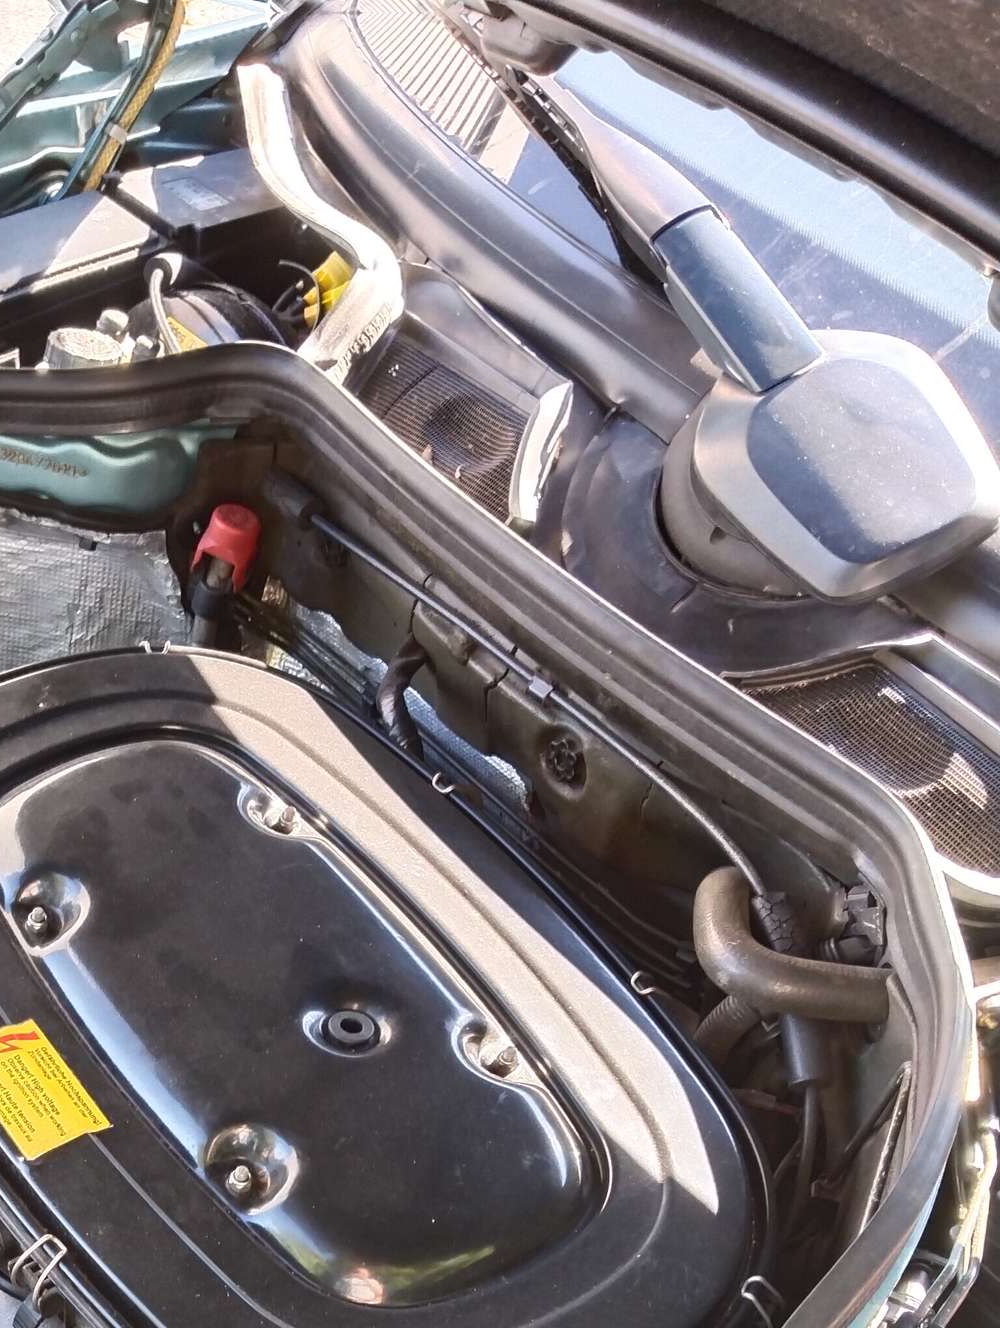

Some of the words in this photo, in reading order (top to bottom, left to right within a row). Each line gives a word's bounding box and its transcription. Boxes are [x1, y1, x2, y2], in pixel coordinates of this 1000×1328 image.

[3, 1091, 19, 1108] Haute
[12, 1055, 33, 1077] Danger!
[30, 1078, 44, 1091] High
[41, 1093, 61, 1114] voltage
[24, 1080, 41, 1099] caution
[38, 1100, 51, 1114] when
[48, 1116, 67, 1135] working
